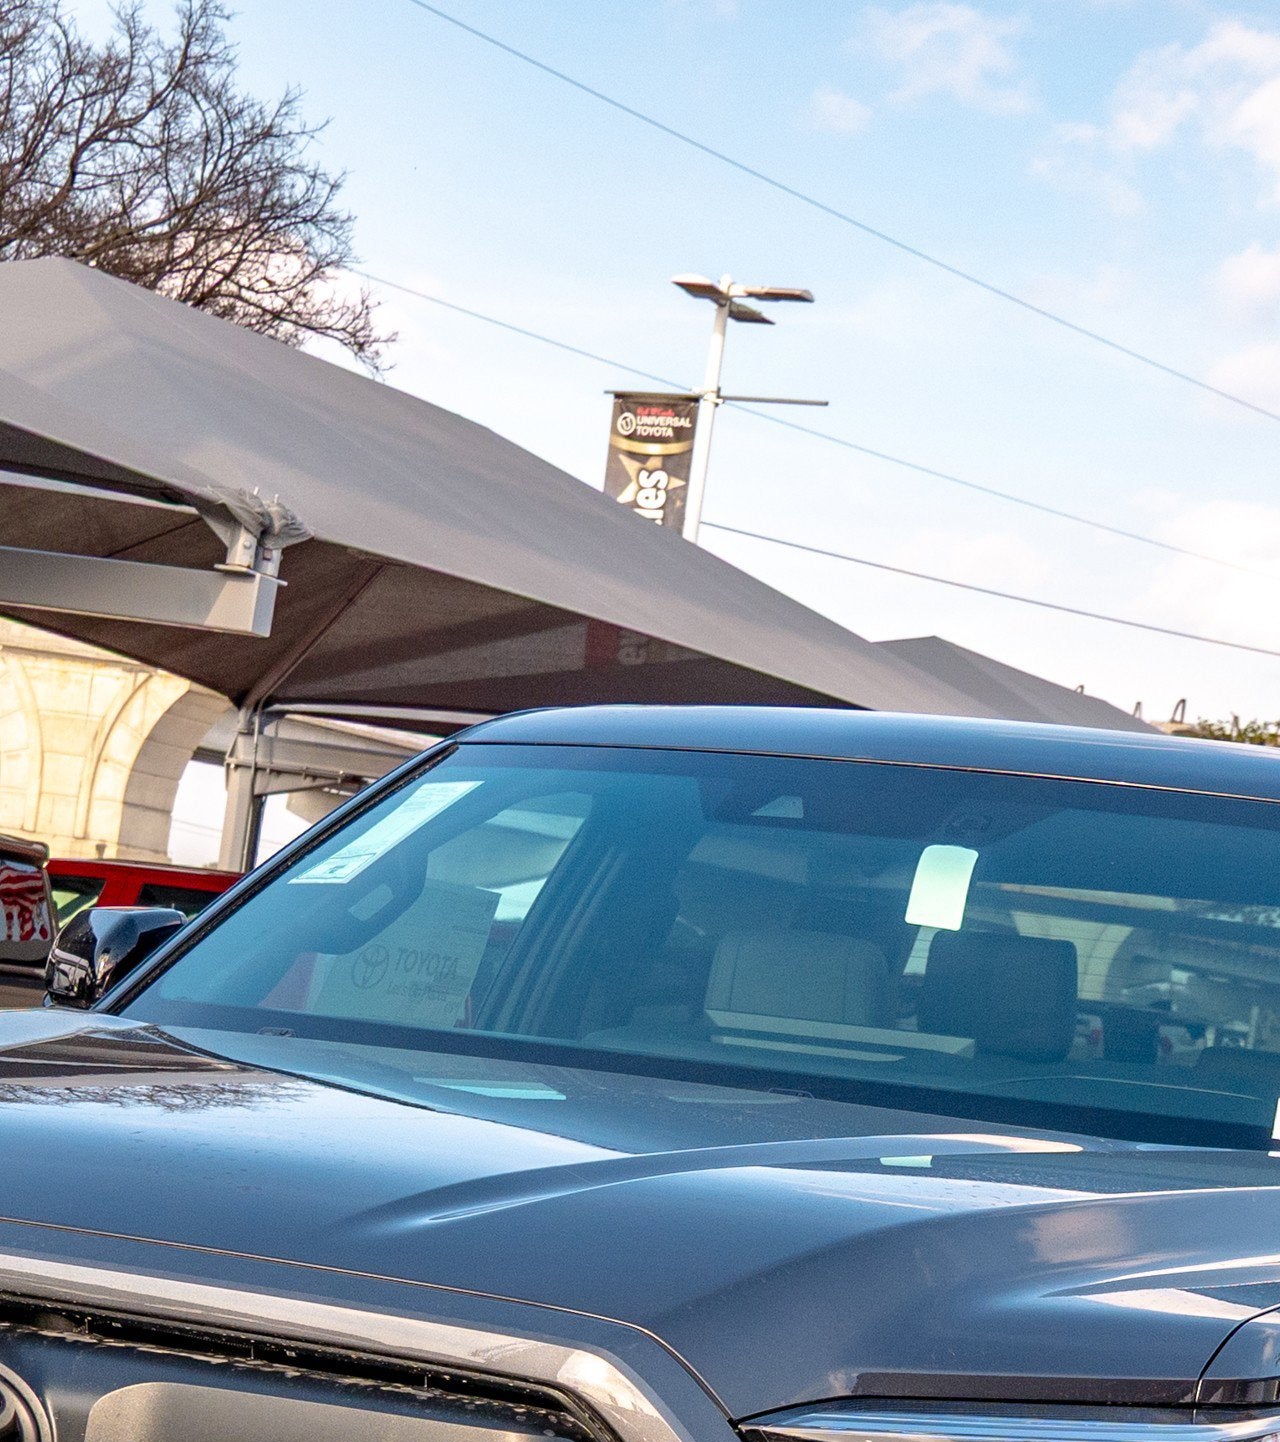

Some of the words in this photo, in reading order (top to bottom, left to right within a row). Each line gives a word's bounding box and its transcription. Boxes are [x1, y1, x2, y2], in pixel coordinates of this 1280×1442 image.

[636, 415, 692, 428] UNIVERSAL
[636, 425, 674, 437] TOYOTA
[394, 946, 459, 982] TOYOTA
